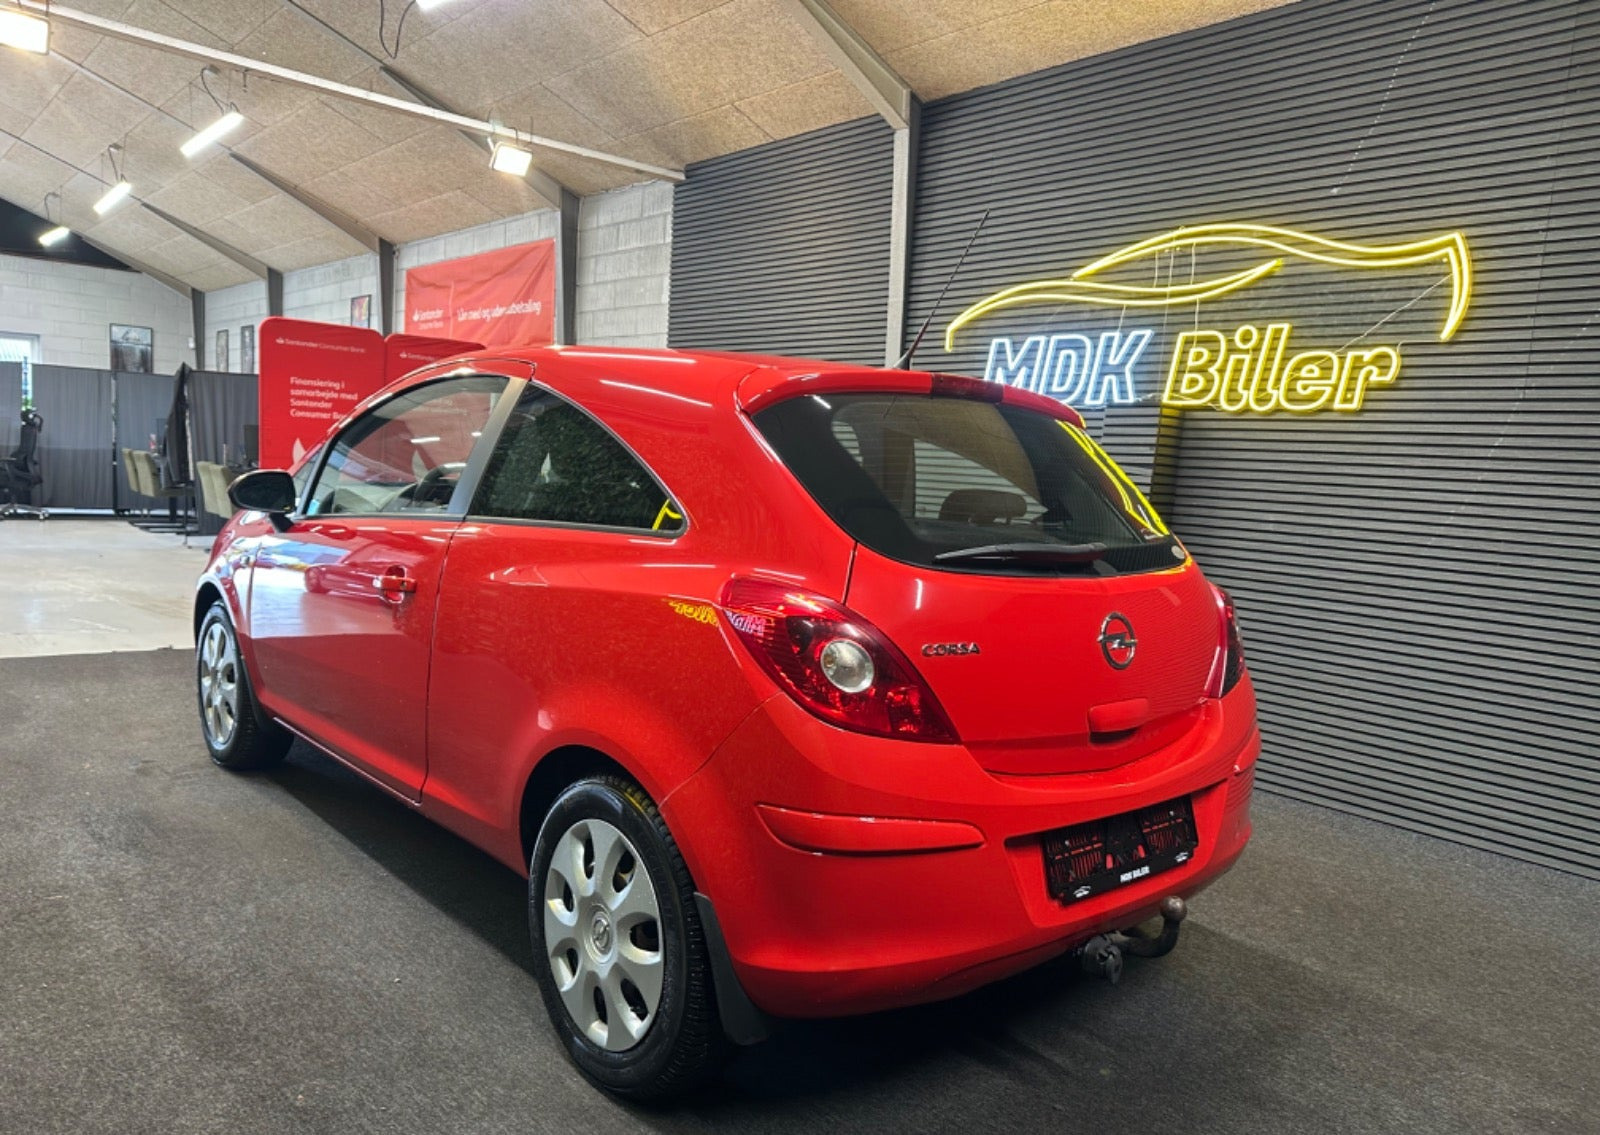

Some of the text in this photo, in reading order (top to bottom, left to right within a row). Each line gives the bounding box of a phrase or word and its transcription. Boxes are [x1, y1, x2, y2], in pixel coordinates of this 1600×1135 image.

[983, 323, 1400, 413] MDK Biler
[290, 376, 340, 390] Finansiering
[290, 388, 358, 401] samarbejde med
[290, 398, 333, 409] Santander
[290, 408, 331, 419] Consumer
[921, 641, 981, 658] CORSA
